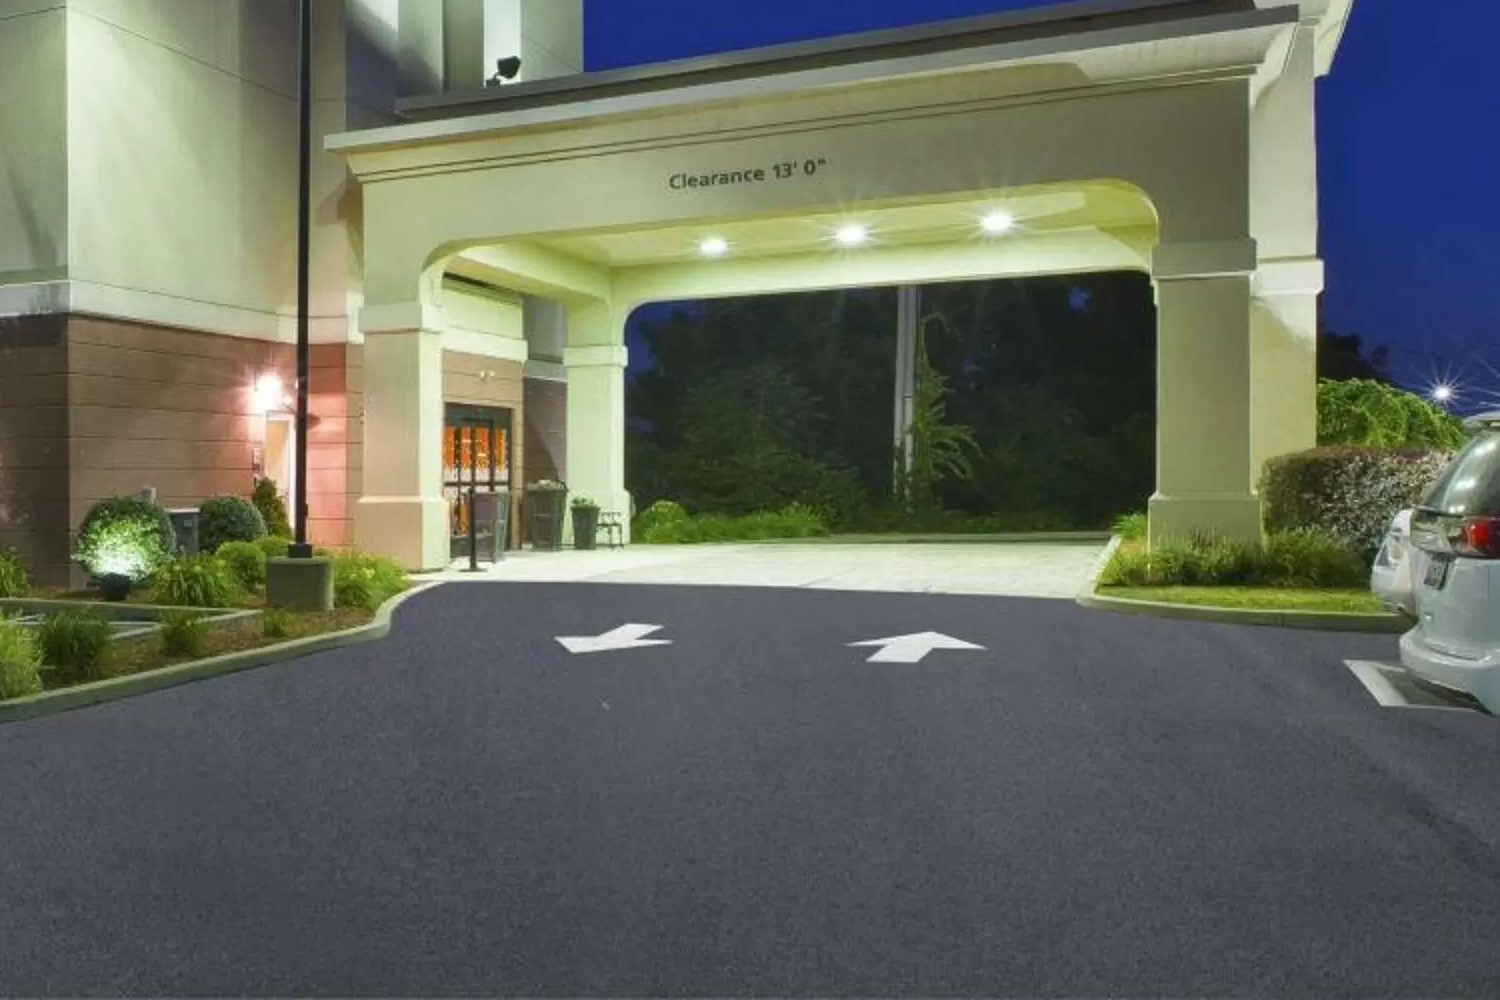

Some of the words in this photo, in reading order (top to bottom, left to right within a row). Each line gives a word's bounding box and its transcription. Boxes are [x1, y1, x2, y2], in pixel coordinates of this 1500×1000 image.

[668, 167, 765, 190] Clearance
[771, 160, 798, 180] 13'
[803, 158, 827, 177] 0"
